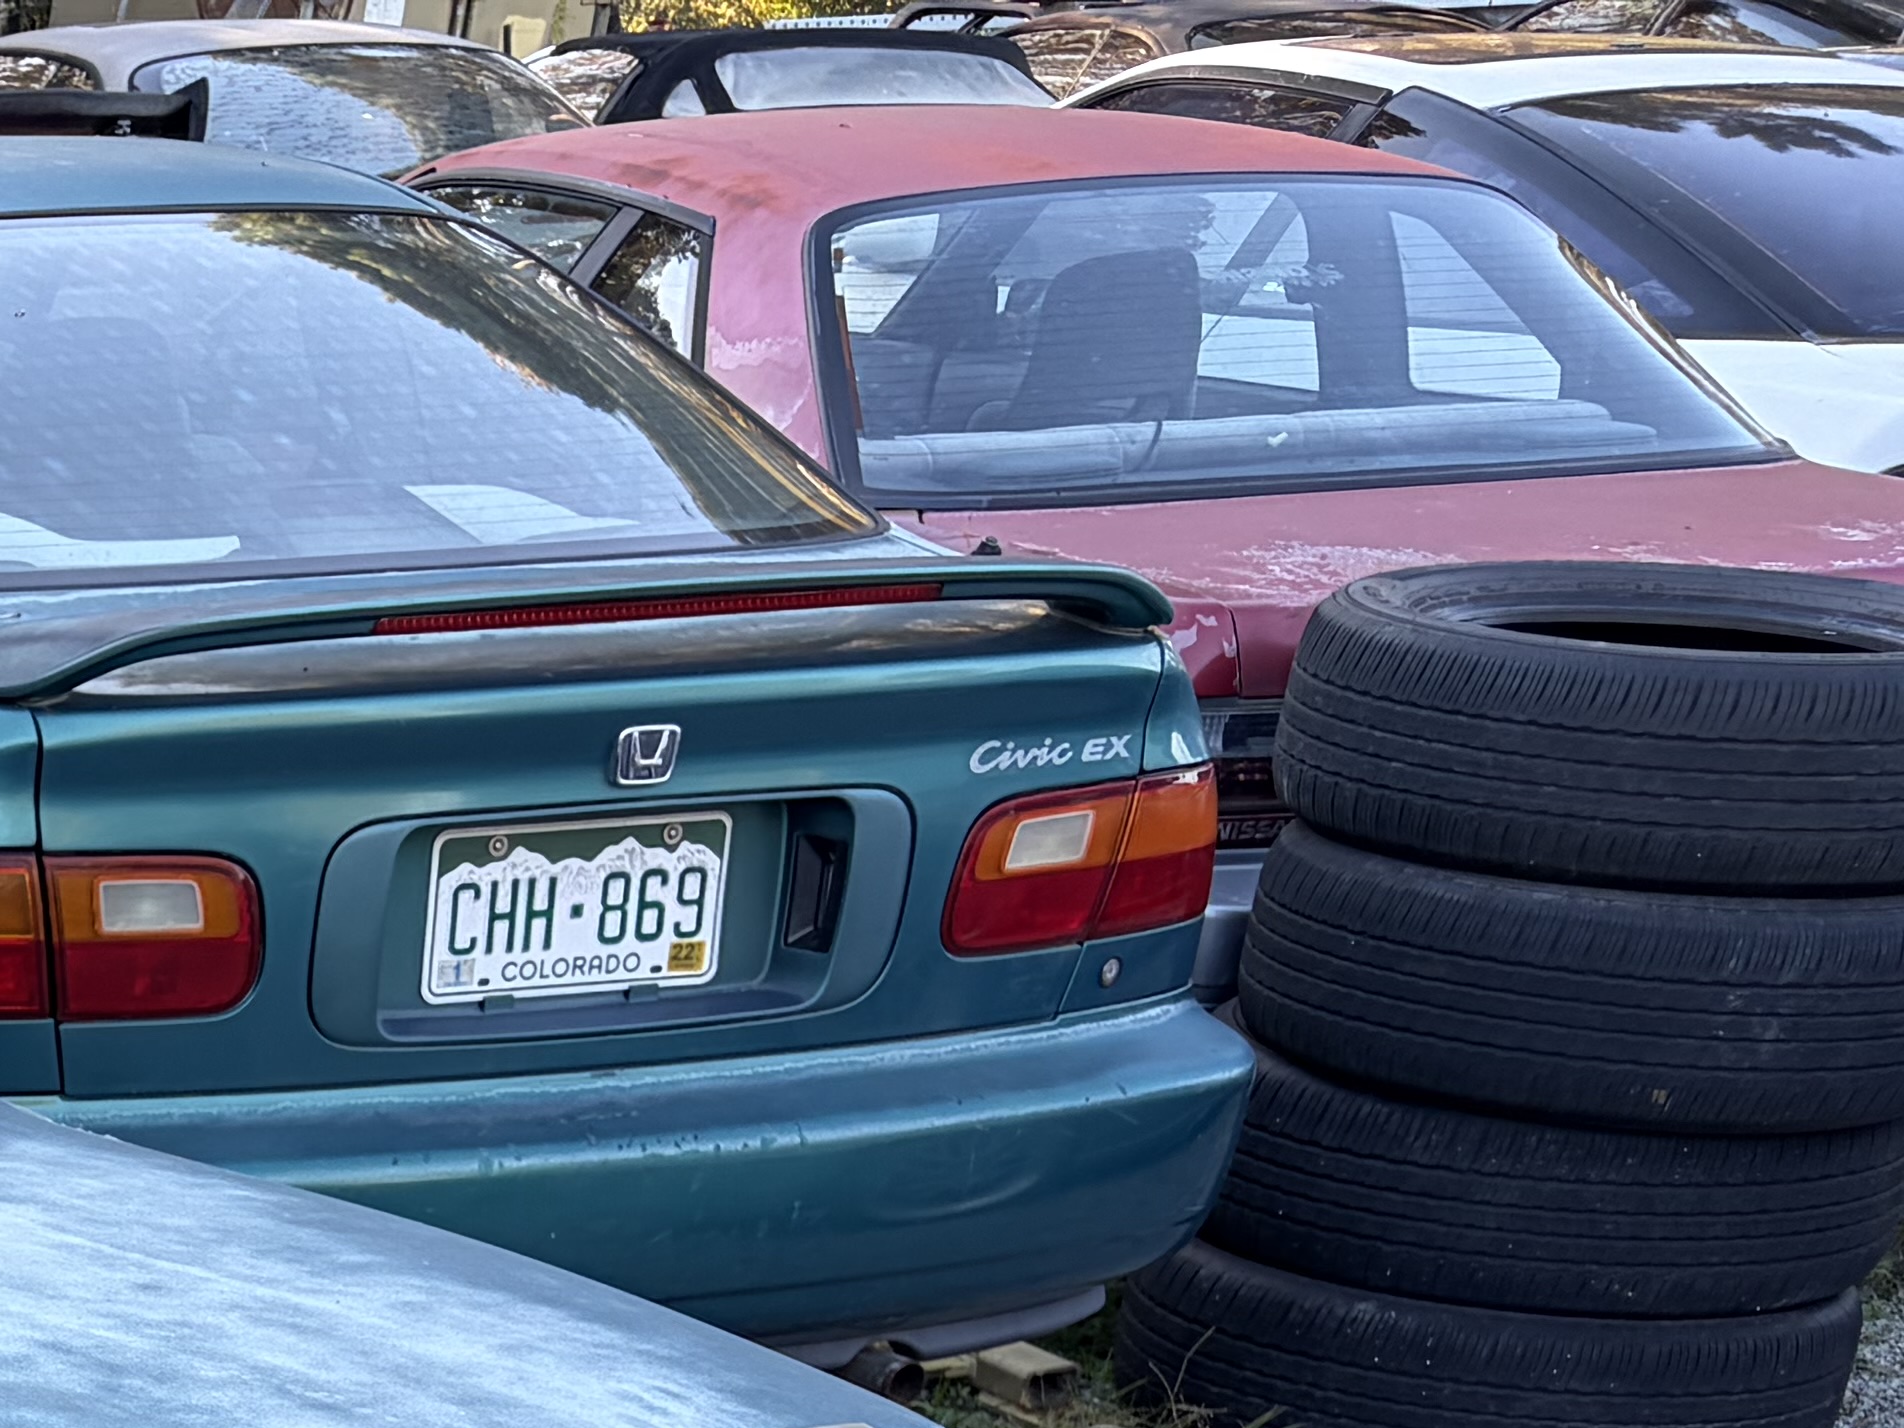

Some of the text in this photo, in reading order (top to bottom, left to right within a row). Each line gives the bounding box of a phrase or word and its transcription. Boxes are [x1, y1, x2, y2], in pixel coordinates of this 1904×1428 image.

[970, 734, 1132, 774] Civic EX
[1218, 819, 1286, 841] NISSA
[501, 952, 641, 982] COLORADO
